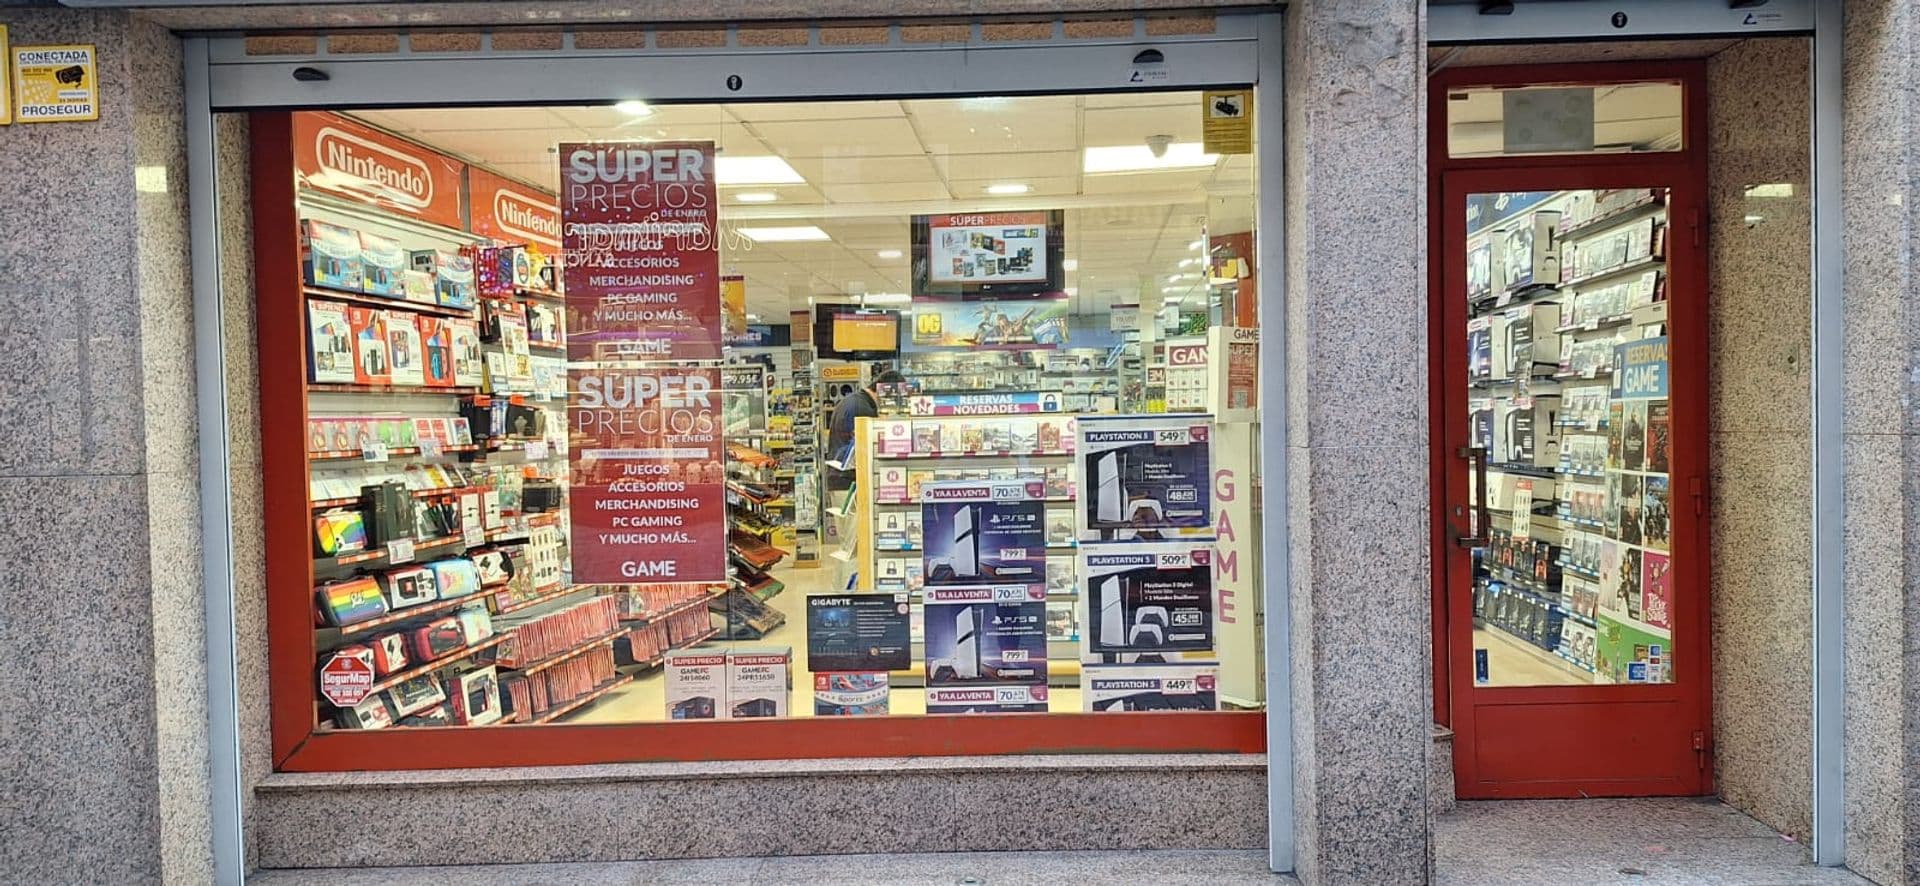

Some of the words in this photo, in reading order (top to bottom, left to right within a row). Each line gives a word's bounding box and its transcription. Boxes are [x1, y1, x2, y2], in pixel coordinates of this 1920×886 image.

[19, 51, 88, 61] CONECTADA
[22, 104, 91, 116] PROSEGUR
[327, 140, 424, 196] Nintendo
[571, 183, 707, 209] PRECIOS
[501, 199, 561, 237] Nintendo
[589, 275, 695, 286] MERCHANDISING
[627, 293, 678, 304] GAMING
[605, 311, 653, 321] MUCHO
[617, 338, 672, 354] GAME
[1625, 364, 1660, 393] GAME
[578, 374, 711, 408] SÚPER
[960, 394, 1013, 404] RESERVAS
[953, 405, 1021, 415] NOVEDADES
[578, 409, 713, 435] PRECIOS
[668, 435, 679, 443] DE
[681, 434, 713, 443] ENERO
[1090, 433, 1143, 441] PLAYSTATION
[1160, 431, 1179, 441] 549
[622, 464, 670, 475] JUEGOS
[608, 481, 685, 492] ACCESORIOS
[995, 488, 1008, 498] 70
[595, 498, 700, 510] MERCHANDISING
[612, 517, 628, 527] PC
[631, 516, 683, 527] GAMING
[599, 534, 609, 544] Y
[610, 534, 657, 545] MUCHO
[1215, 469, 1238, 624] GAME
[1092, 556, 1143, 564] PLAYSTATION
[1161, 555, 1180, 565] 509
[621, 560, 676, 577] GAME
[998, 589, 1010, 598] 70
[811, 598, 851, 606] GIGABYTE
[698, 656, 722, 664] PRECIO
[759, 656, 783, 664] PRECIO
[1096, 681, 1148, 689] PLAYSTATION
[1166, 680, 1186, 690] 449
[1000, 691, 1013, 700] 70
